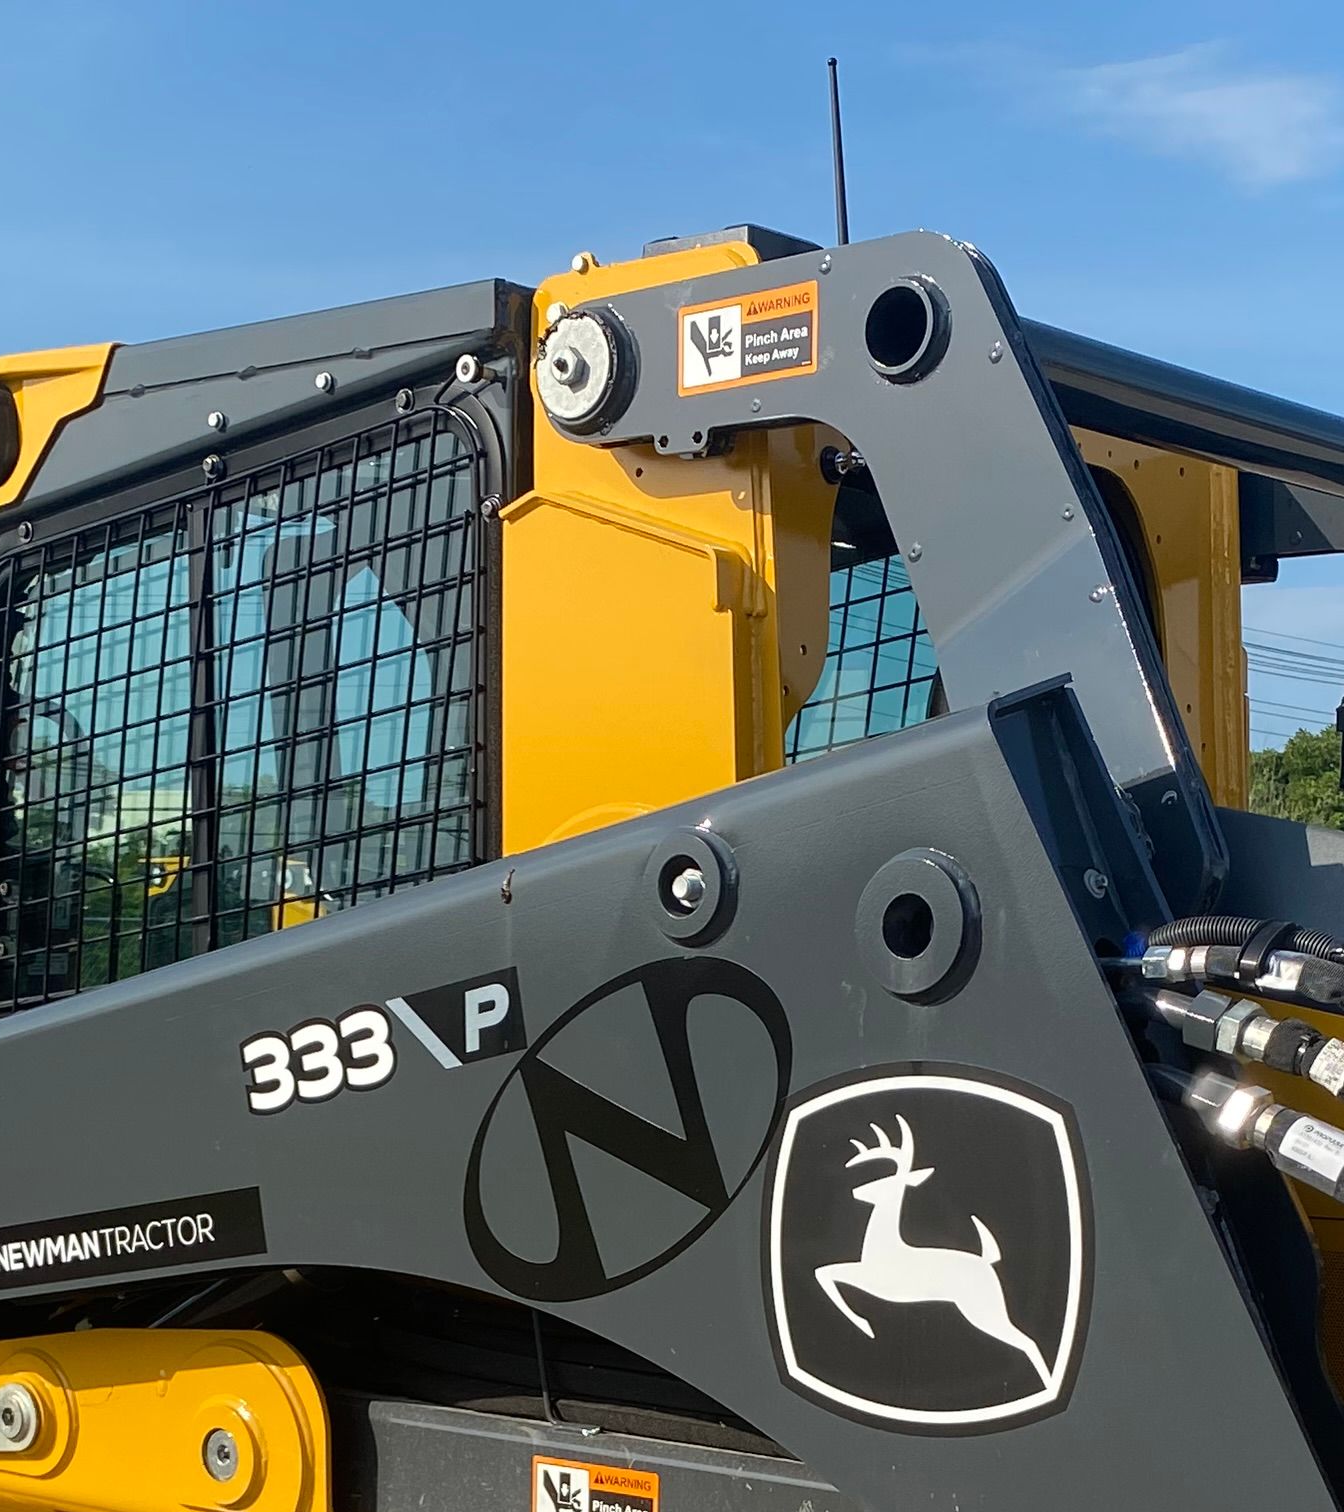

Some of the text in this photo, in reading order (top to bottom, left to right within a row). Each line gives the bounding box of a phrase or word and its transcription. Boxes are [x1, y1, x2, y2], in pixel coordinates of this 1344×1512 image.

[758, 293, 810, 312] WARNING
[745, 326, 808, 348] Pinch Area
[745, 347, 799, 365] Keep Away
[242, 1009, 395, 1111] 333
[604, 1477, 651, 1491] WARNING
